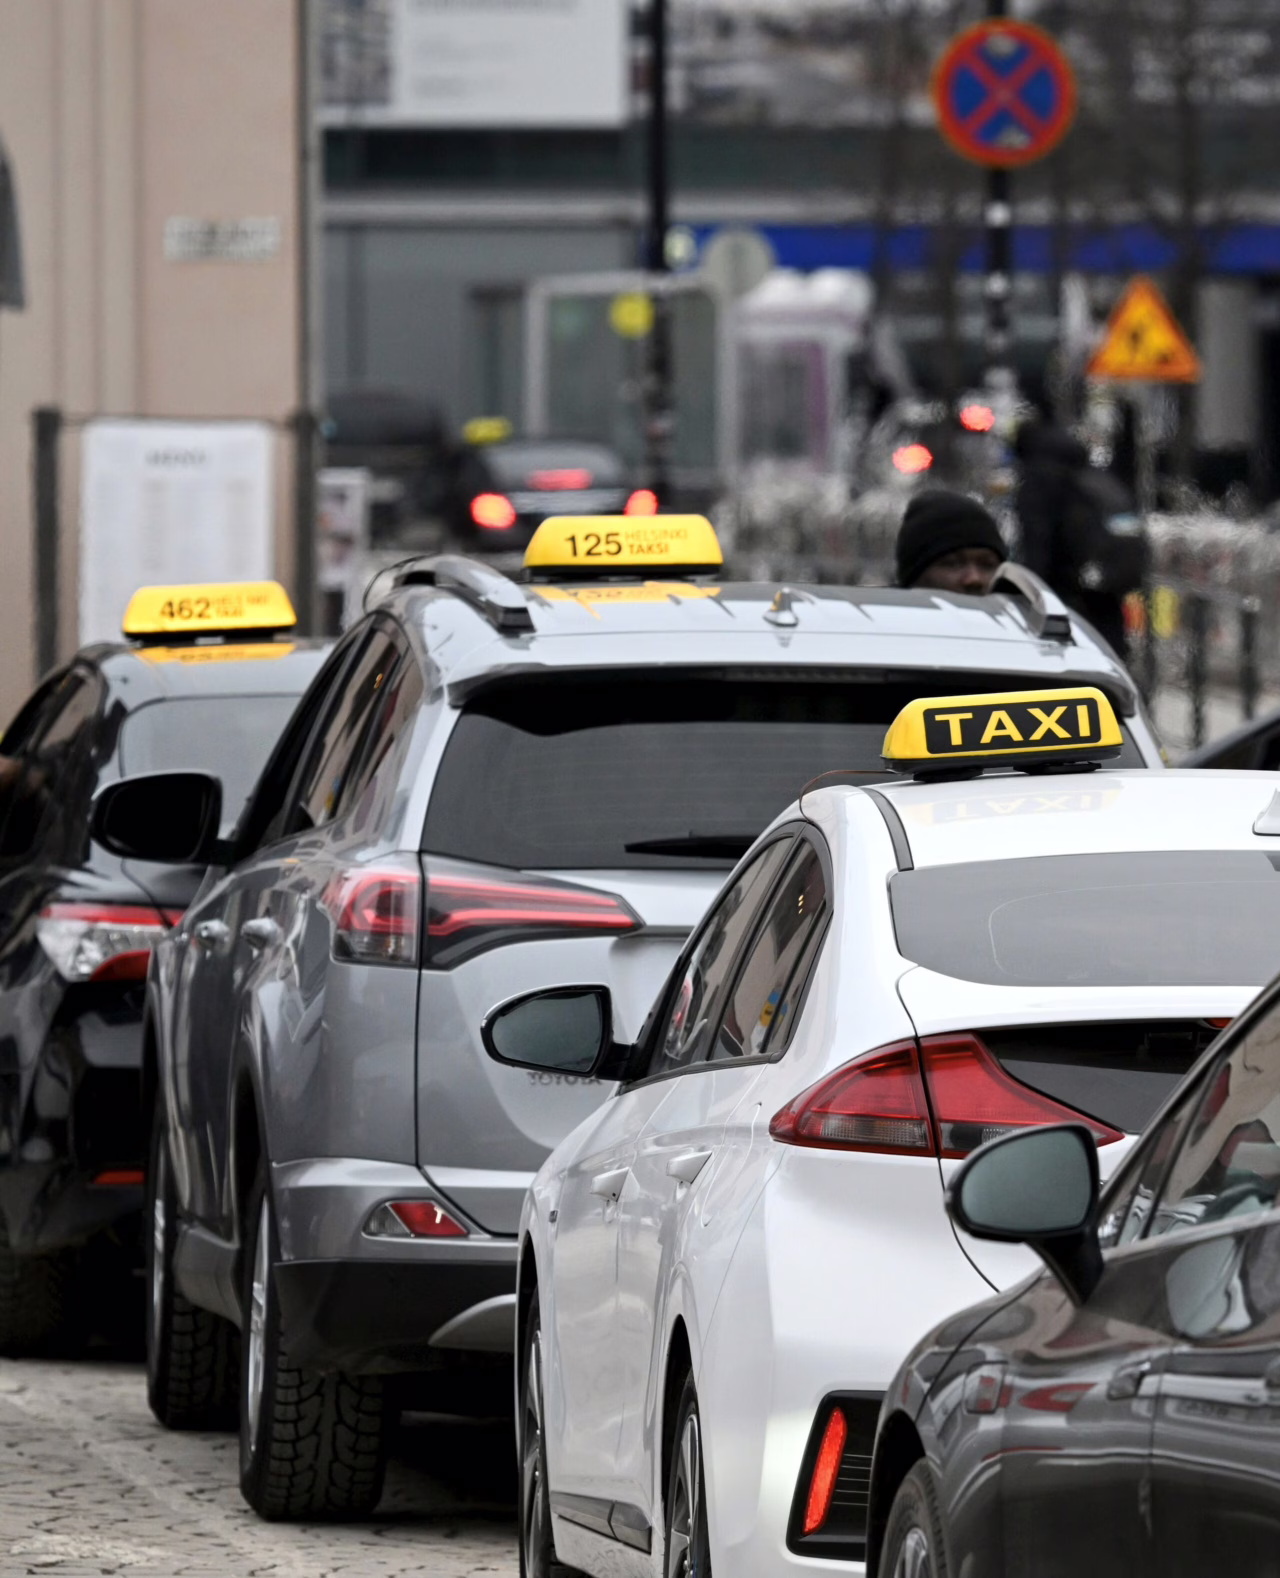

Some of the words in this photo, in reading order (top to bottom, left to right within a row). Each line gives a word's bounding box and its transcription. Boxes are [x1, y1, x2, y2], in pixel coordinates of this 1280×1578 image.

[565, 532, 622, 557] 125
[625, 529, 688, 542] HELSINKI
[629, 543, 669, 555] TAKSI
[160, 598, 211, 619] 462
[934, 704, 1091, 746] TAXI
